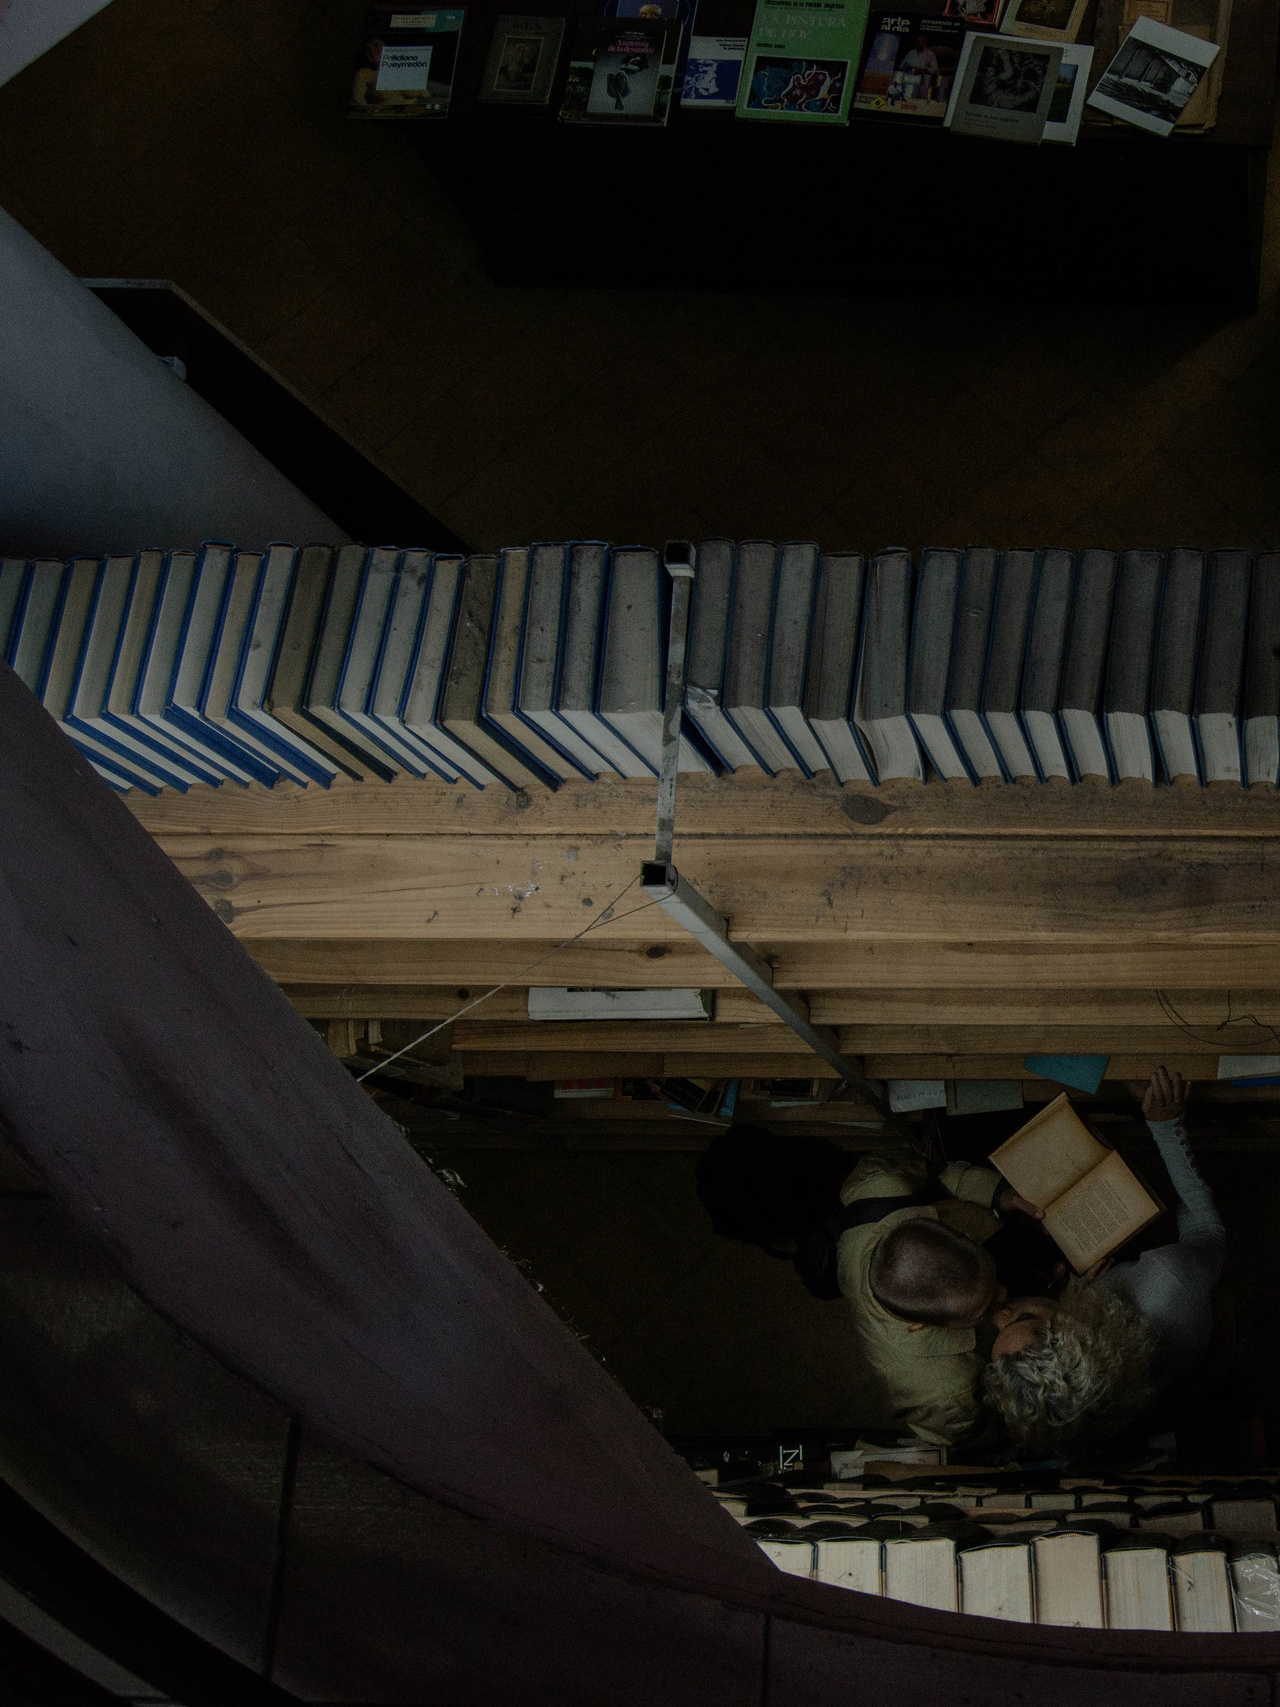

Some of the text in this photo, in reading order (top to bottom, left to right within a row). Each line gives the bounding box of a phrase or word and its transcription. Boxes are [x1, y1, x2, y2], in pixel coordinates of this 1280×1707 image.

[760, 12, 846, 28] LA PINTURA
[881, 16, 911, 26] arte
[758, 27, 809, 39] DE HOY
